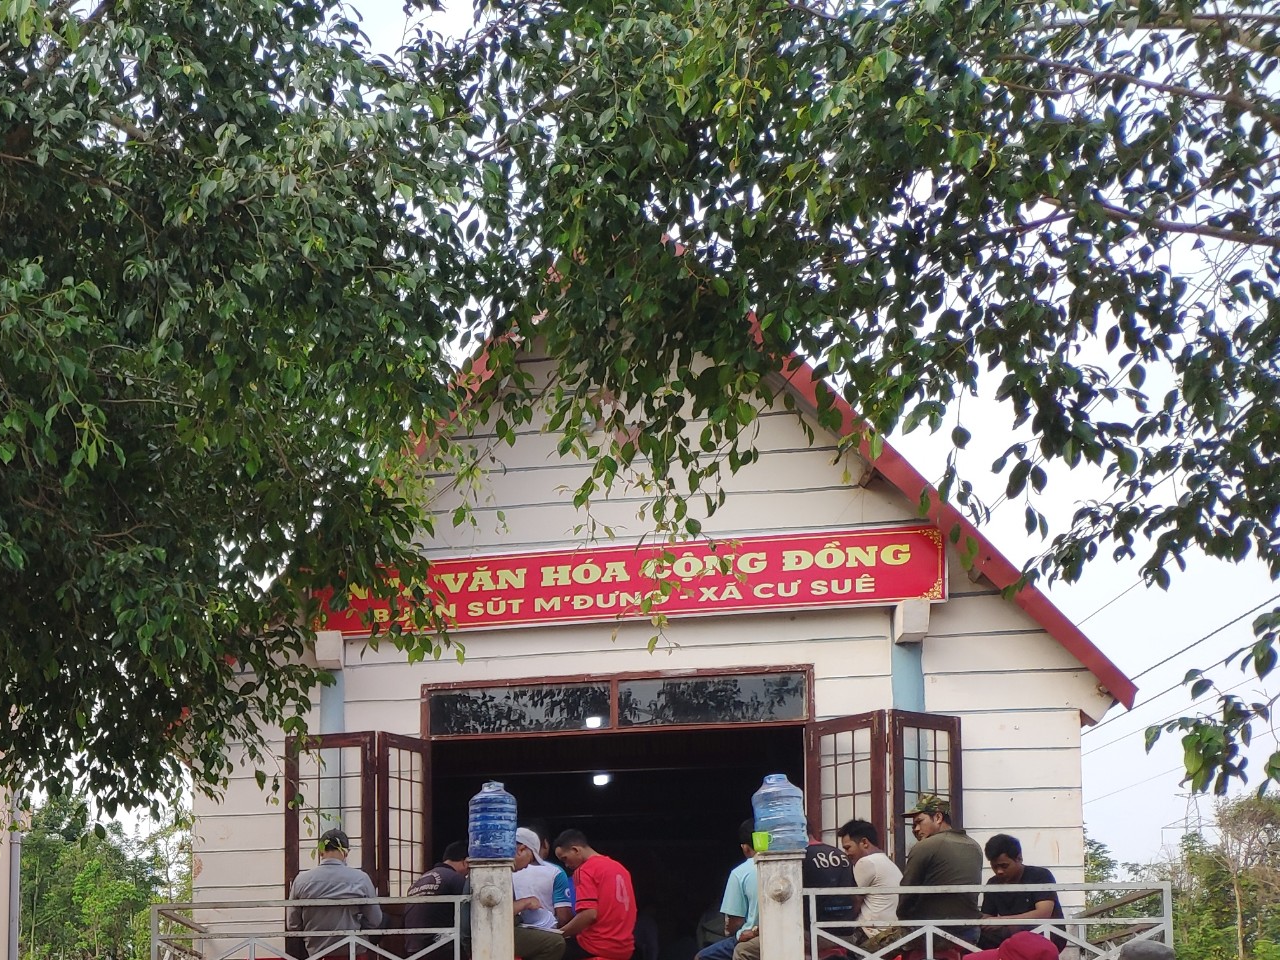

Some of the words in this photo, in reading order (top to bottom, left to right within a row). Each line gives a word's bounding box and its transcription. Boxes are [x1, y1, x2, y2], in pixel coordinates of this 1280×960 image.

[440, 566, 526, 594] VĂN
[541, 559, 631, 587] HÓA
[642, 551, 768, 582] CỘNG
[782, 541, 912, 571] ĐỒNG
[698, 582, 743, 602] XÃ
[753, 579, 802, 598] CƯ
[810, 574, 876, 595] SUÊ
[812, 850, 850, 869] 1865
[615, 874, 630, 912] 4
